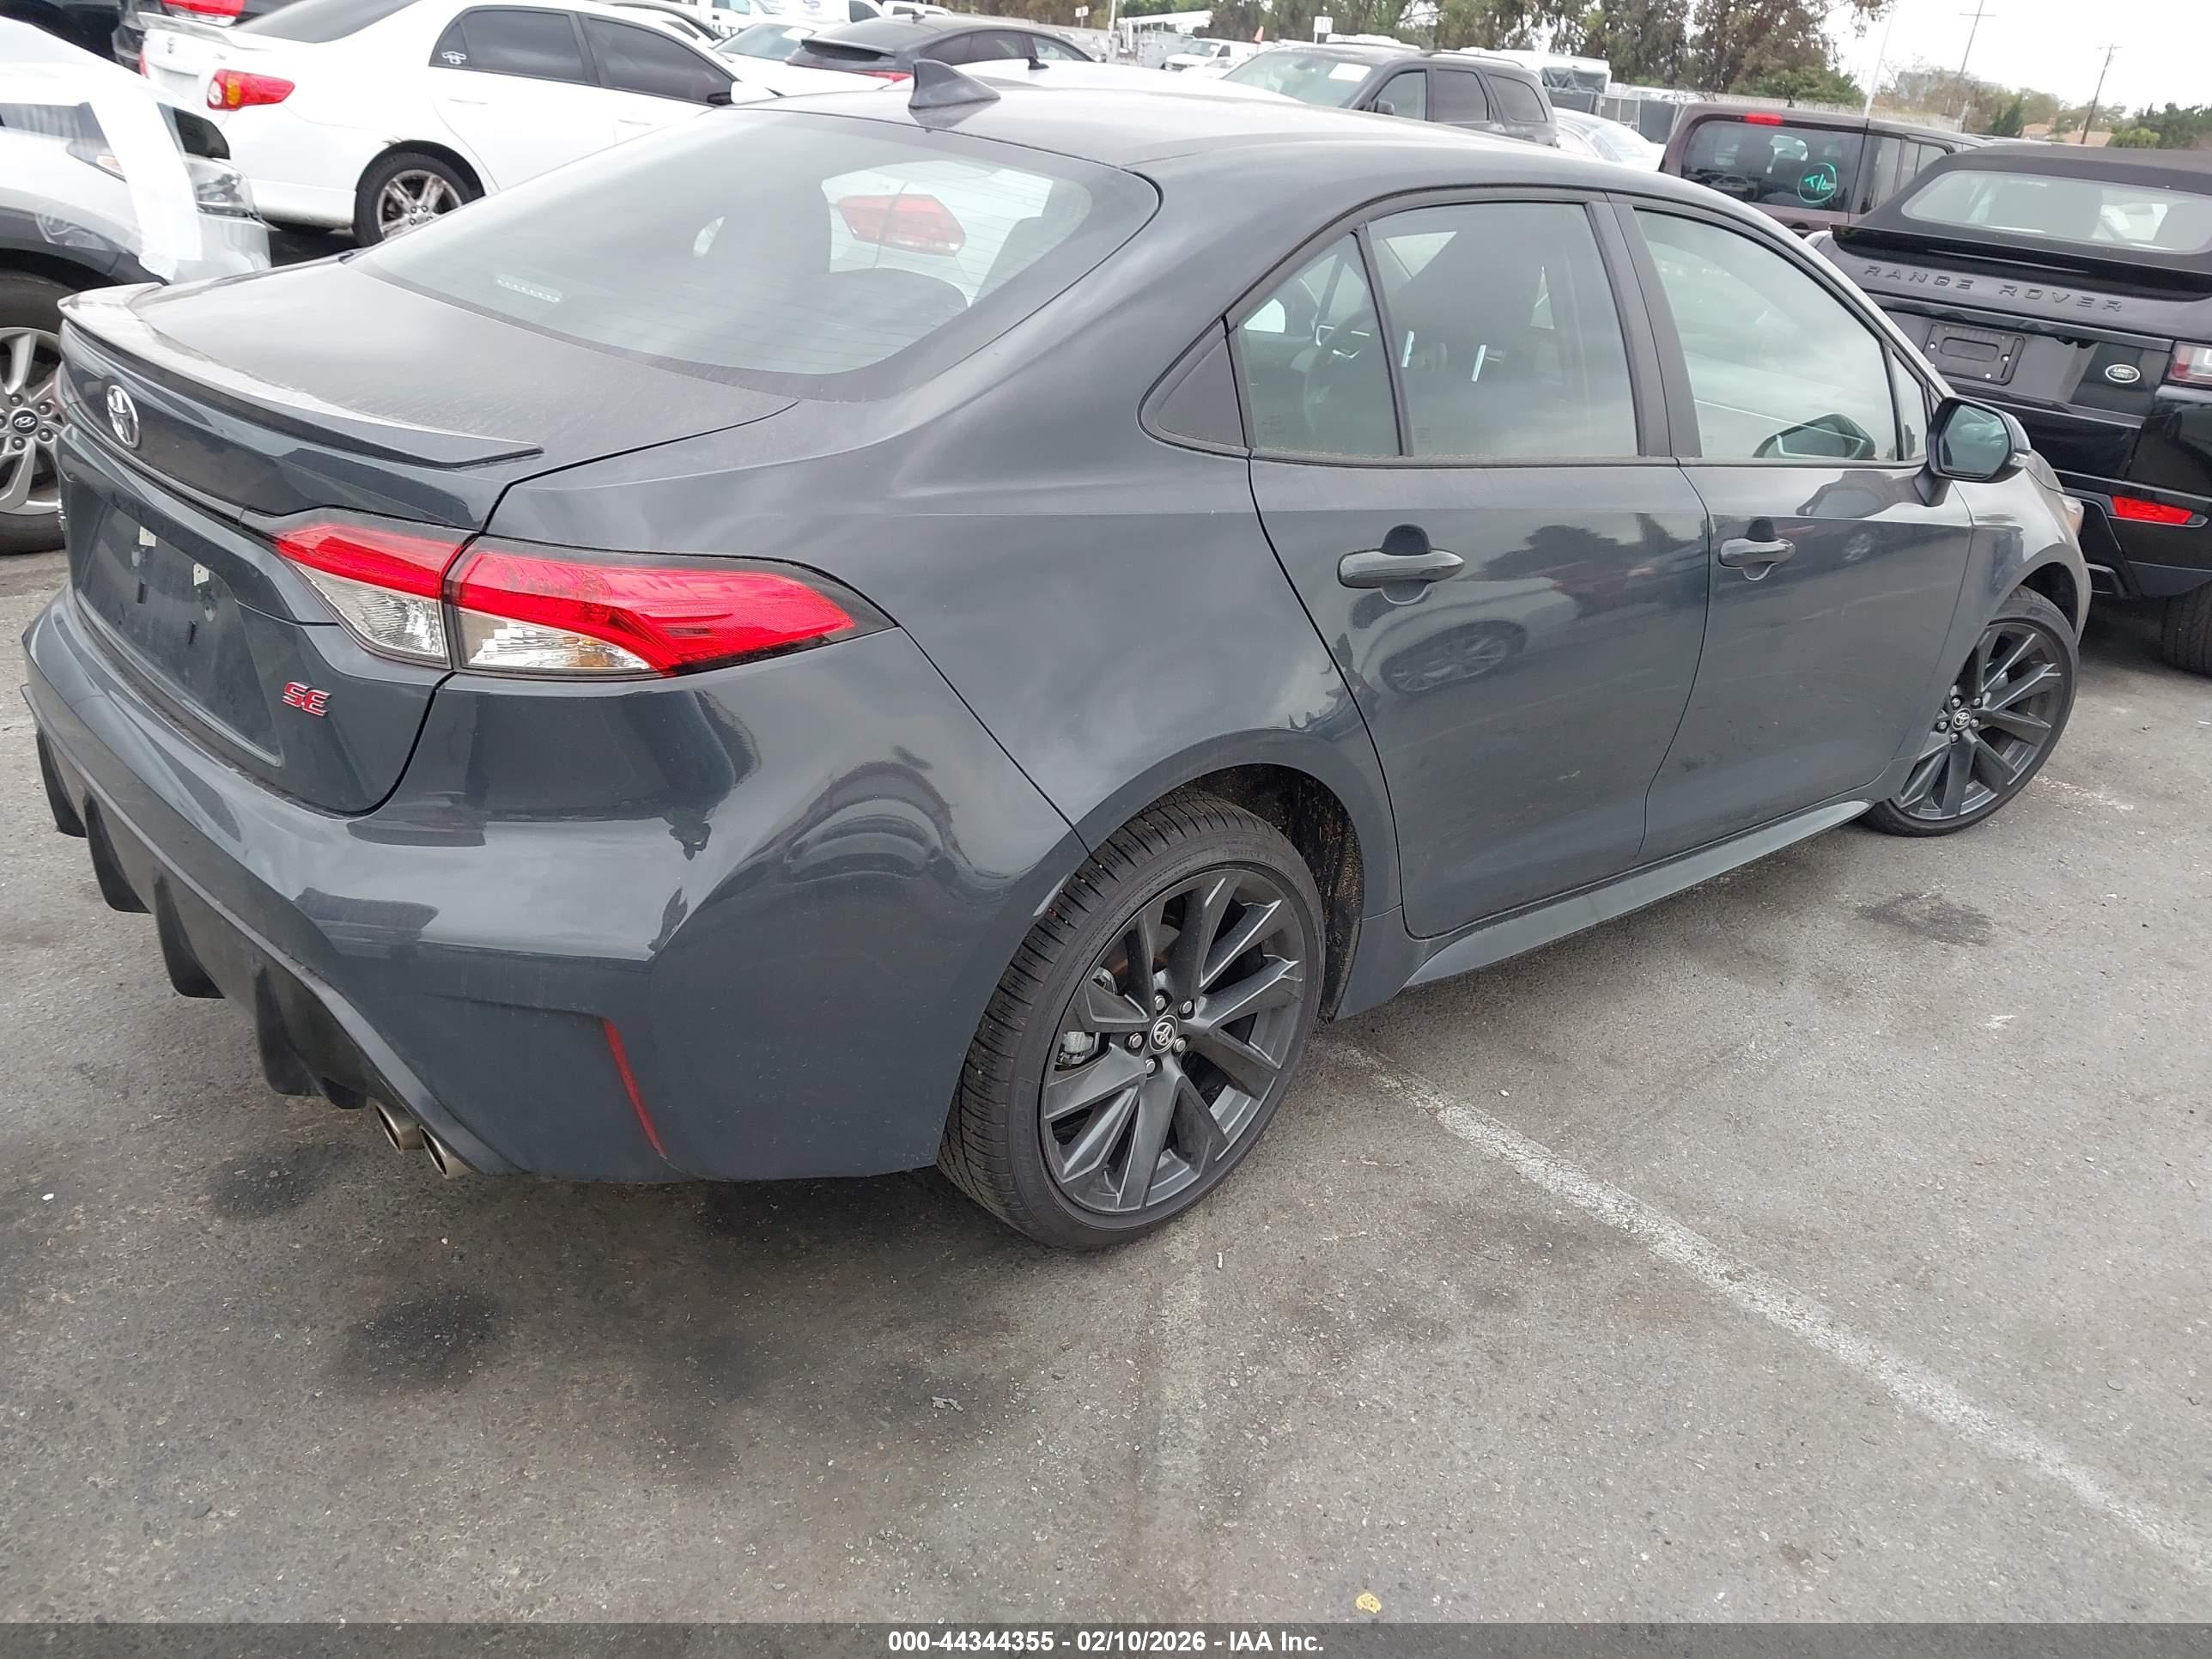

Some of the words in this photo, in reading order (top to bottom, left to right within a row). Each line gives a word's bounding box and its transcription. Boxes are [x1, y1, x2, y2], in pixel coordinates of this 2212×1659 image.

[1863, 264, 1975, 290] RANGE
[1998, 283, 2123, 313] ROVER
[282, 681, 331, 717] SE
